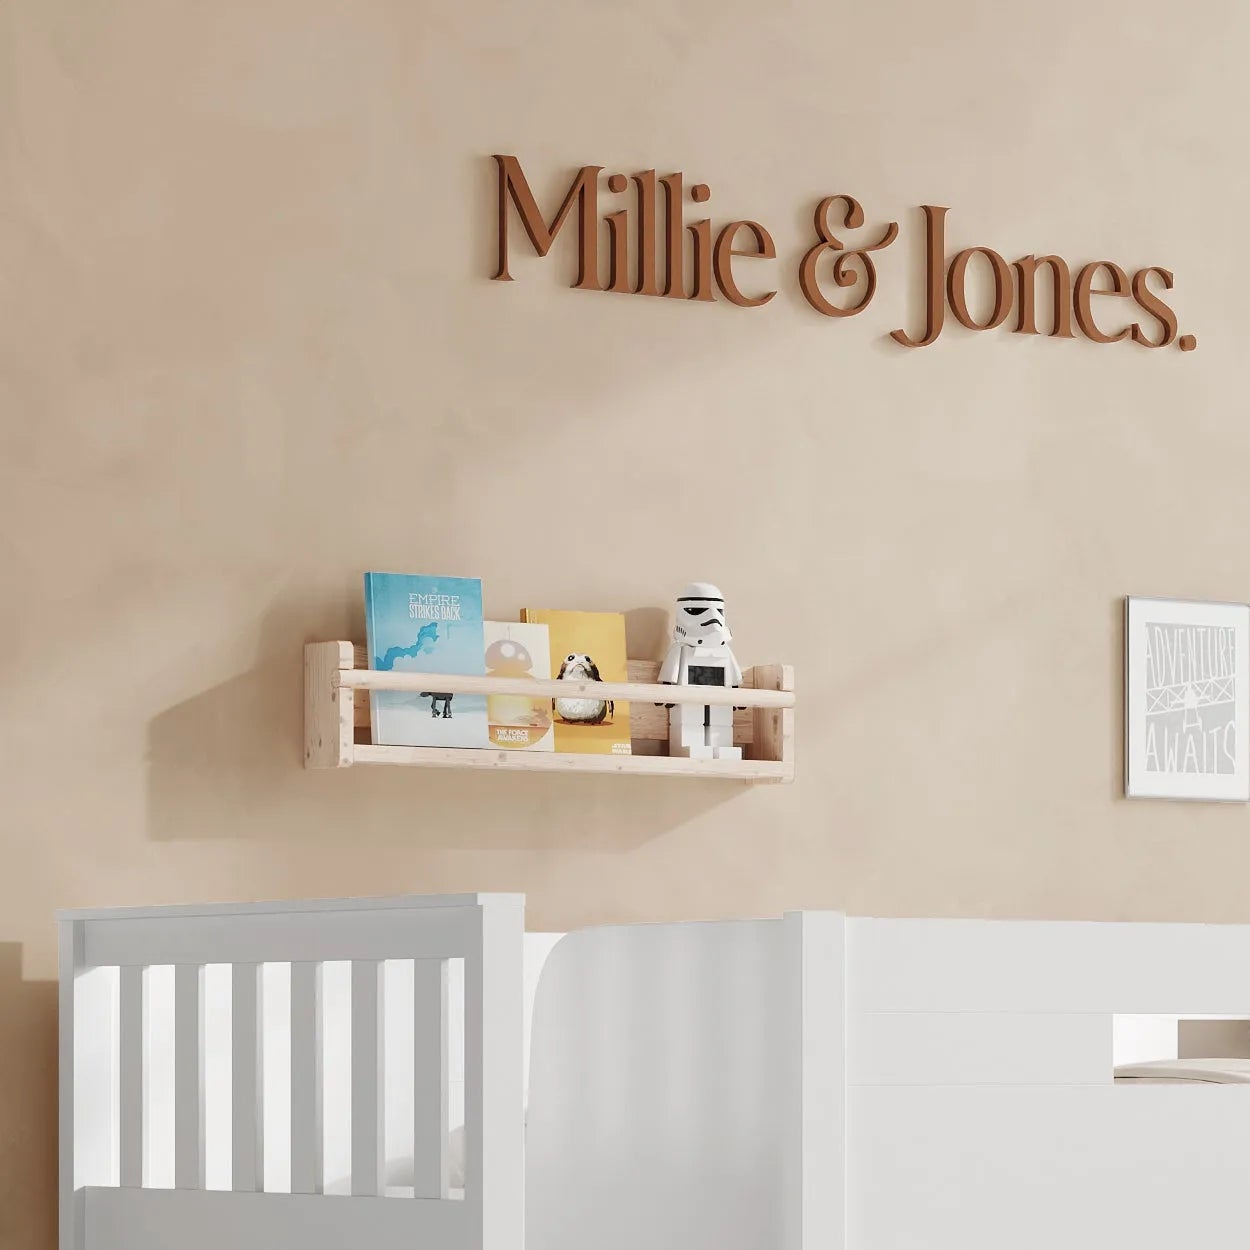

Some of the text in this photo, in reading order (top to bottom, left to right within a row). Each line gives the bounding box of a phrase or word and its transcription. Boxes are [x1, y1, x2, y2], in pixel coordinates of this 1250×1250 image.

[490, 154, 1198, 352] Millie & Jones.
[408, 592, 461, 607] EMPIRE
[409, 604, 461, 621] STRIKES BACK
[1145, 625, 1236, 689] ADVENTURE
[1145, 719, 1236, 775] AWAITS
